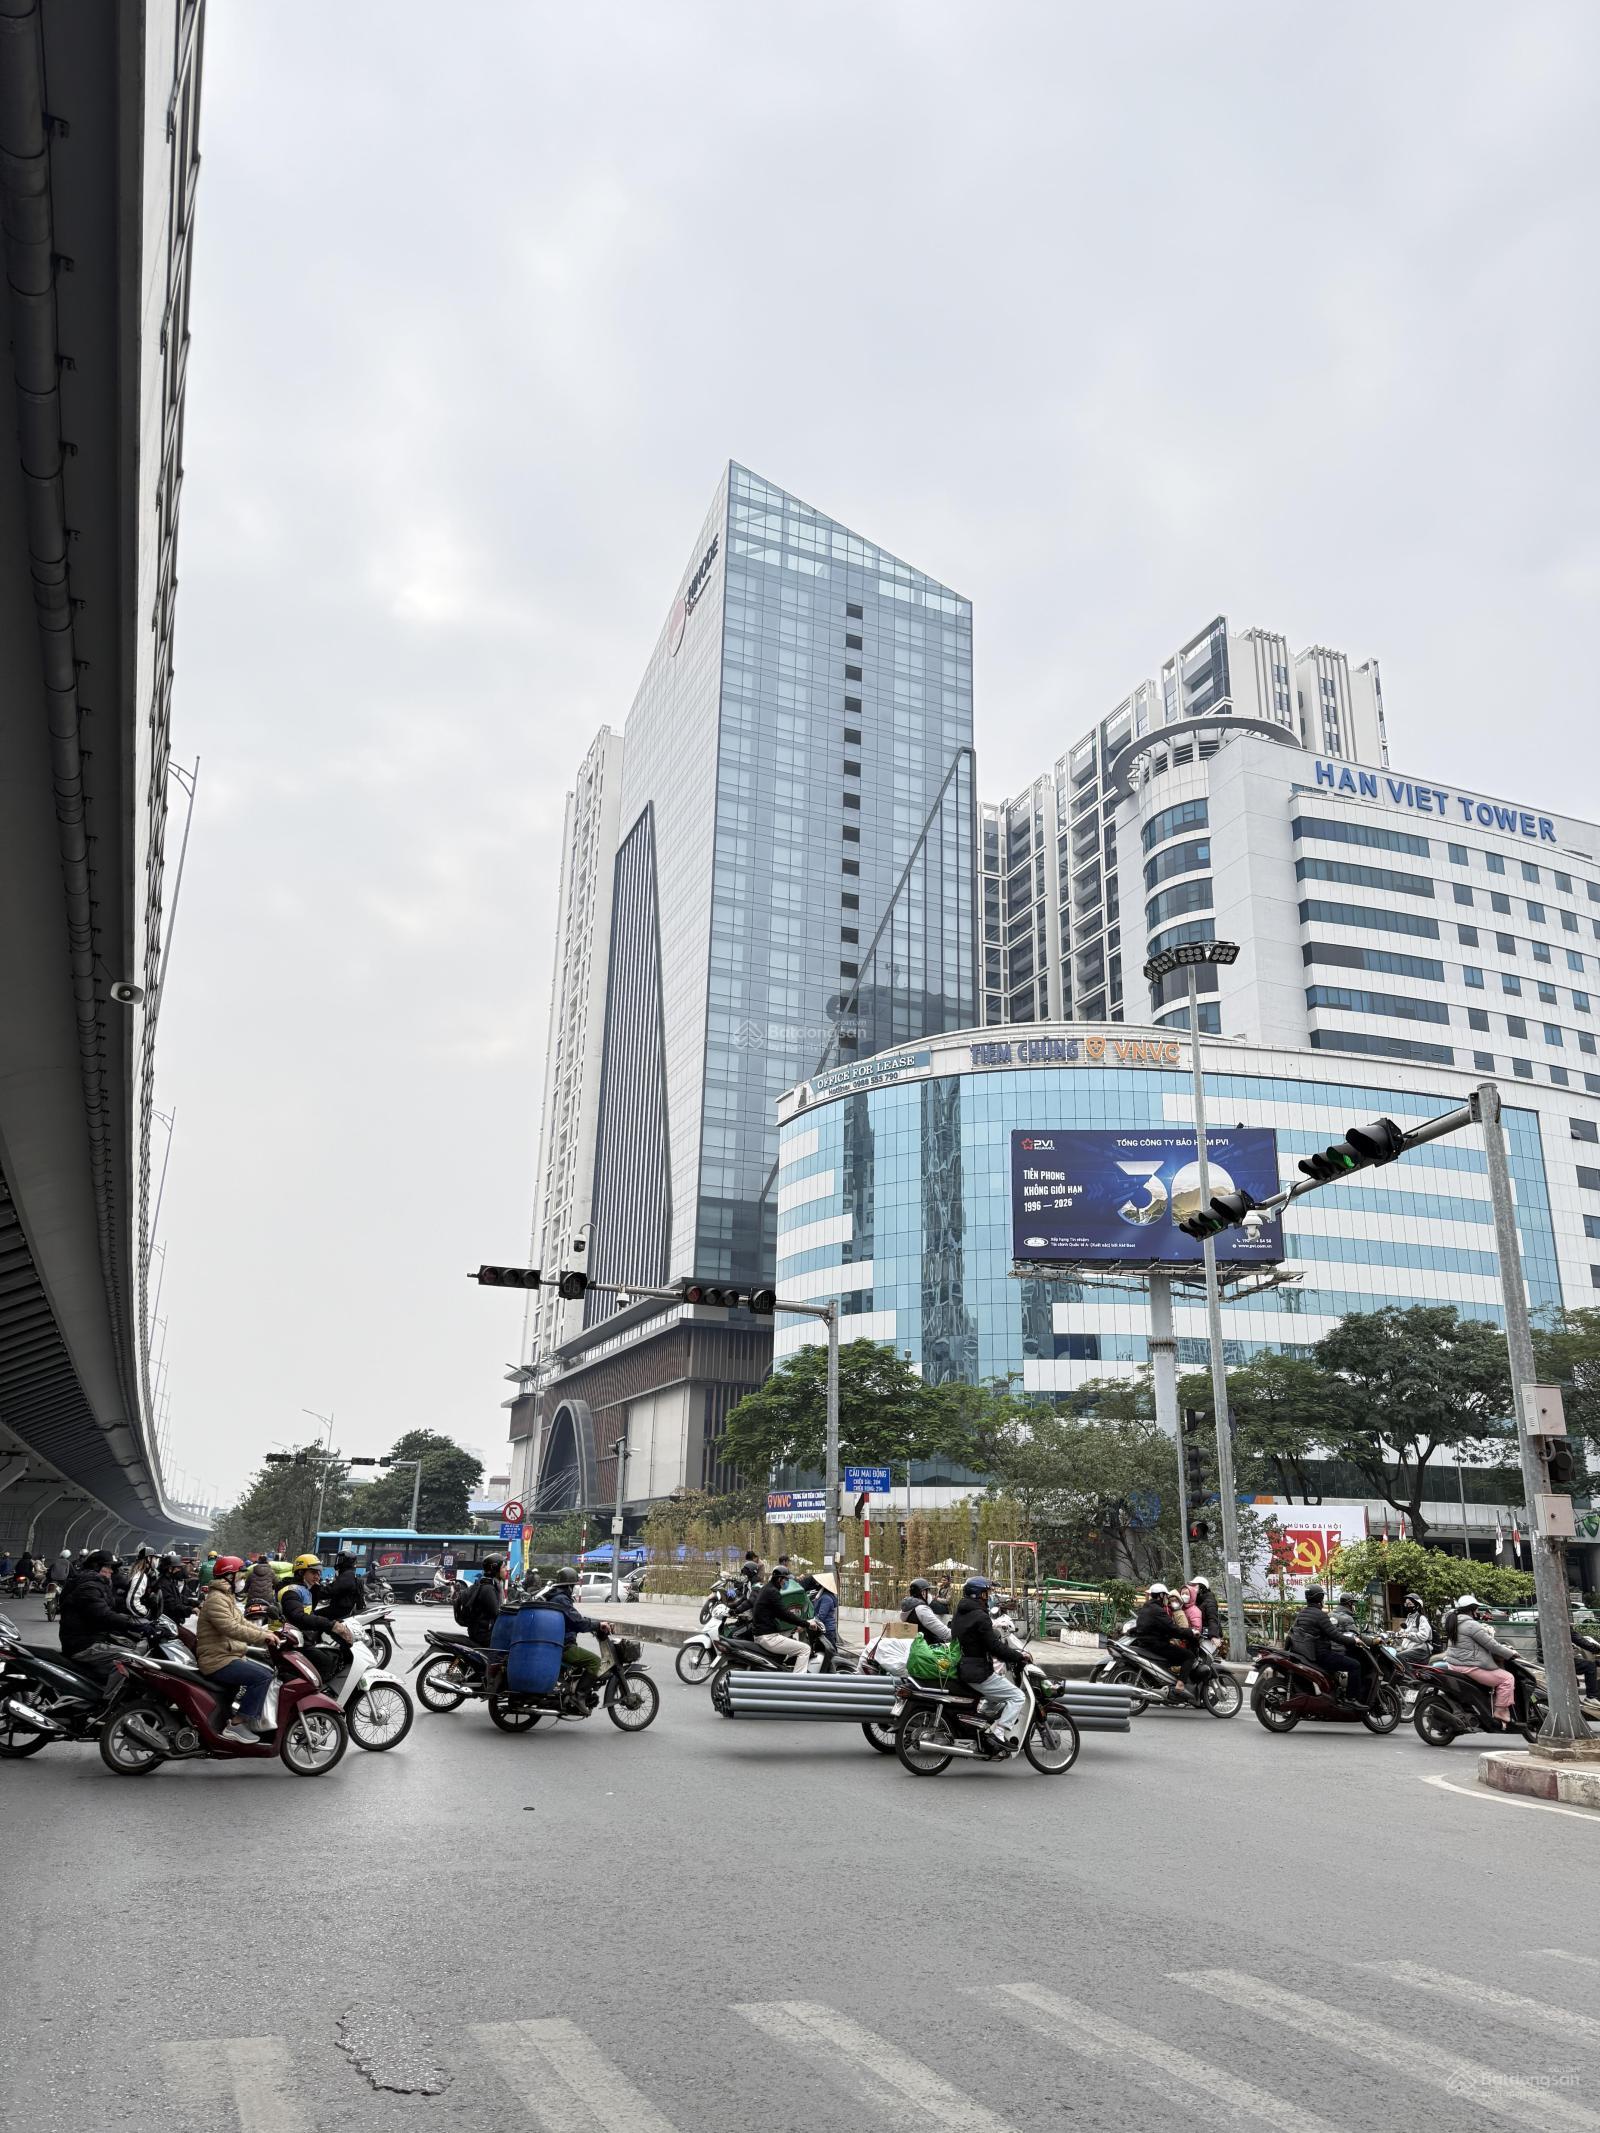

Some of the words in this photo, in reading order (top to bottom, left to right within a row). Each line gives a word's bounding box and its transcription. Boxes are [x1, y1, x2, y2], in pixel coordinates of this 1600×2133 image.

[1315, 760, 1378, 799] HAN
[1386, 778, 1449, 815] VIET
[1457, 796, 1557, 842] TOWER
[1114, 1040, 1181, 1062] VNVC
[817, 1070, 850, 1090] OFFICE
[852, 1066, 874, 1079] FOR
[876, 1055, 916, 1073] LEASE
[884, 1072, 899, 1083] 790
[1033, 1139, 1054, 1148] PVI
[1117, 1138, 1138, 1147] TỔNG
[1139, 1137, 1162, 1147] CÔNG
[1175, 1137, 1193, 1146] BẢO
[1193, 1138, 1214, 1146] HM
[1215, 1138, 1229, 1146] PVI
[1040, 1170, 1066, 1181] PHONG
[1023, 1183, 1049, 1197] KHÔNG
[1067, 1185, 1083, 1196] HẠN
[1023, 1200, 1042, 1212] 1996
[1054, 1197, 1073, 1209] 2026
[848, 1467, 860, 1478] CẦU
[860, 1469, 872, 1478] MAI
[772, 1494, 792, 1508] VNVC
